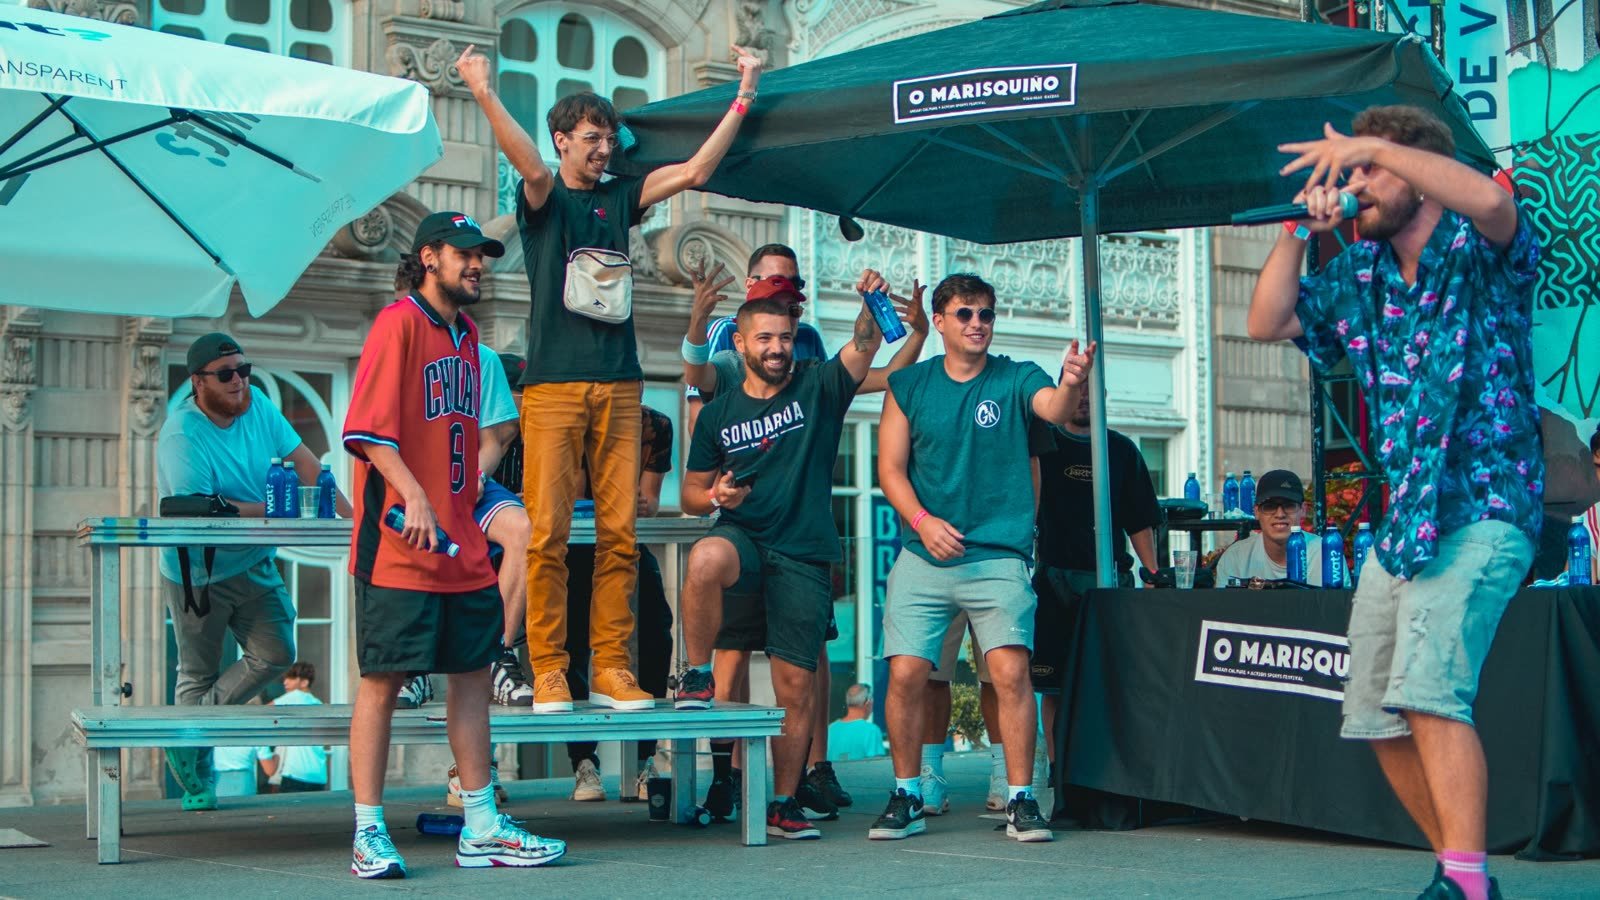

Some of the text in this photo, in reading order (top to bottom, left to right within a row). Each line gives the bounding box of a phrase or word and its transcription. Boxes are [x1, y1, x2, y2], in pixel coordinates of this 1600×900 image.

[0, 59, 127, 91] NSPARENT
[909, 75, 1059, 105] O MARISQUIÑO
[1459, 56, 1498, 120] DE
[266, 483, 275, 514] wat?
[1330, 549, 1341, 584] wat?
[1213, 637, 1233, 662] O
